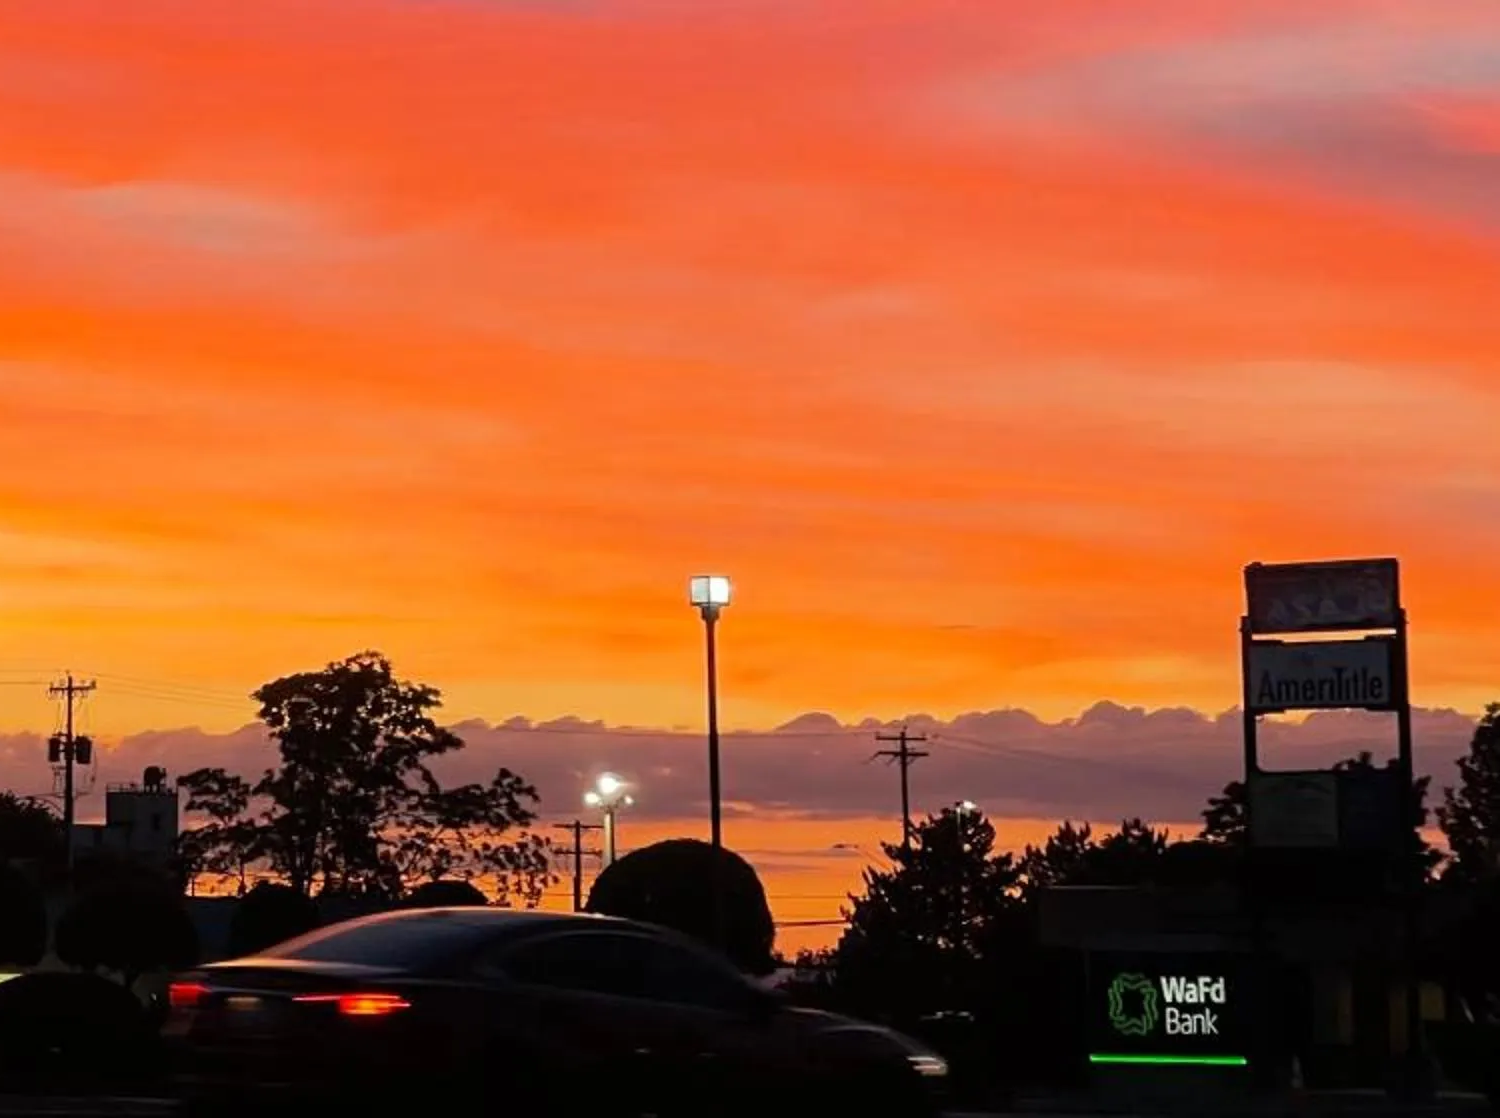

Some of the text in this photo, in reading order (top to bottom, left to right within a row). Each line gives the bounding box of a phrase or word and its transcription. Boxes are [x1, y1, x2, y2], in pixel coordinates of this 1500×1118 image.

[1257, 667, 1384, 704] AmeriTitle
[1159, 975, 1226, 1004] WaFd
[1164, 1007, 1219, 1035] Bank
